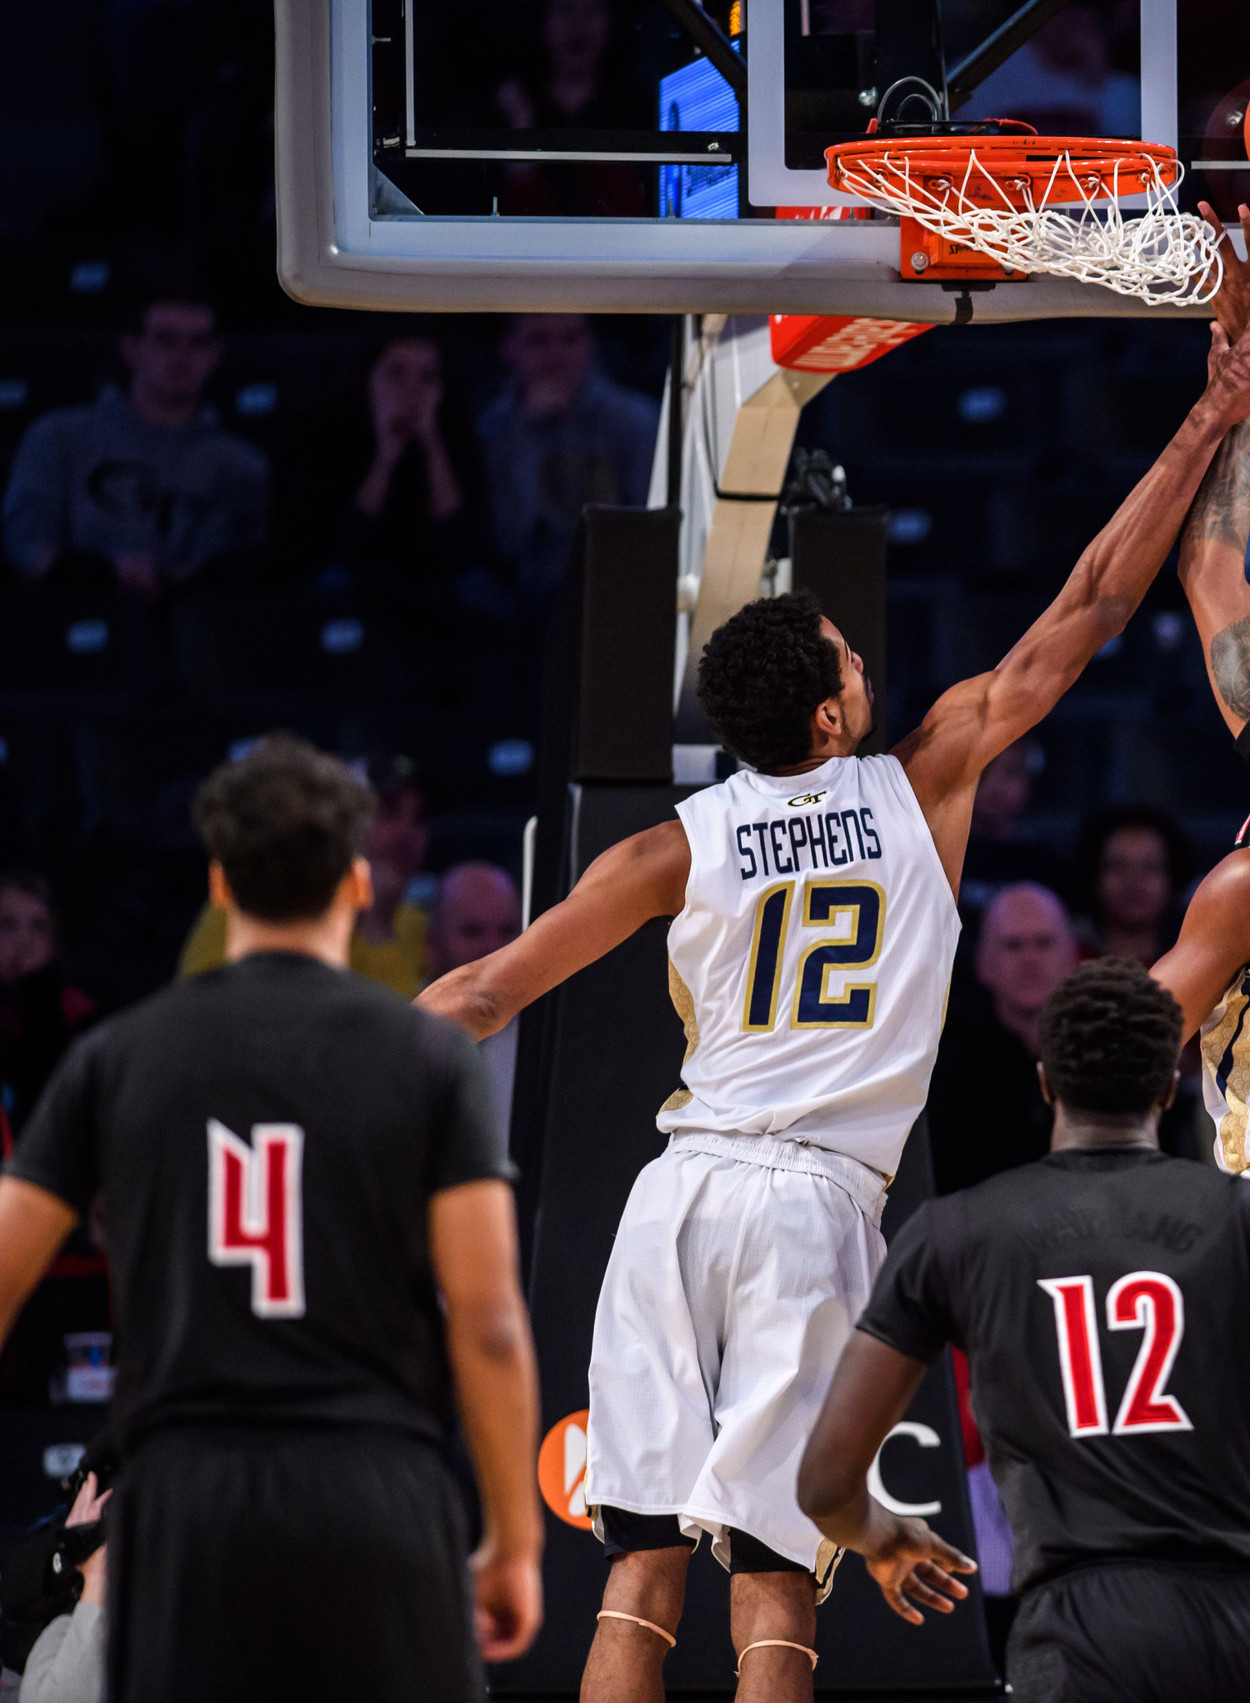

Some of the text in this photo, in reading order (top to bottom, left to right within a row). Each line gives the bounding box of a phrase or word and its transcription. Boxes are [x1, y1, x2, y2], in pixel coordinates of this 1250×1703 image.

[736, 807, 882, 880] STEPHENS
[787, 791, 827, 807] GT
[742, 879, 887, 1032] 12
[206, 1116, 306, 1320] 4
[1036, 1270, 1195, 1438] 12
